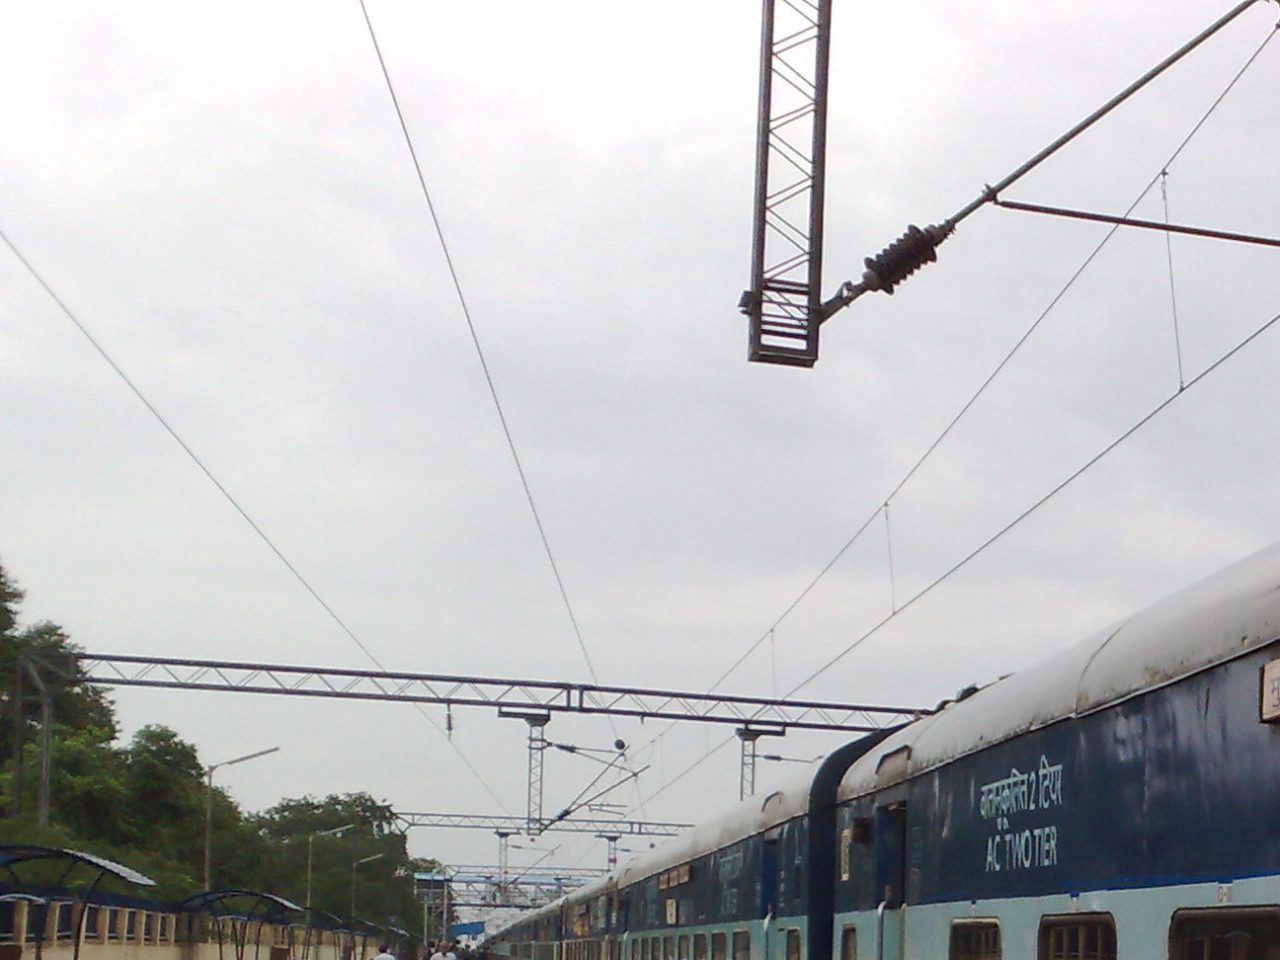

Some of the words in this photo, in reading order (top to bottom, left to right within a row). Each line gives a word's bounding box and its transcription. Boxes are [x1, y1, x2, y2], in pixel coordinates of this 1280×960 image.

[1029, 771, 1036, 811] 2
[1038, 754, 1063, 810] टियर
[985, 835, 1001, 872] AC
[1004, 829, 1032, 870] TWO
[1034, 825, 1058, 867] TIER
